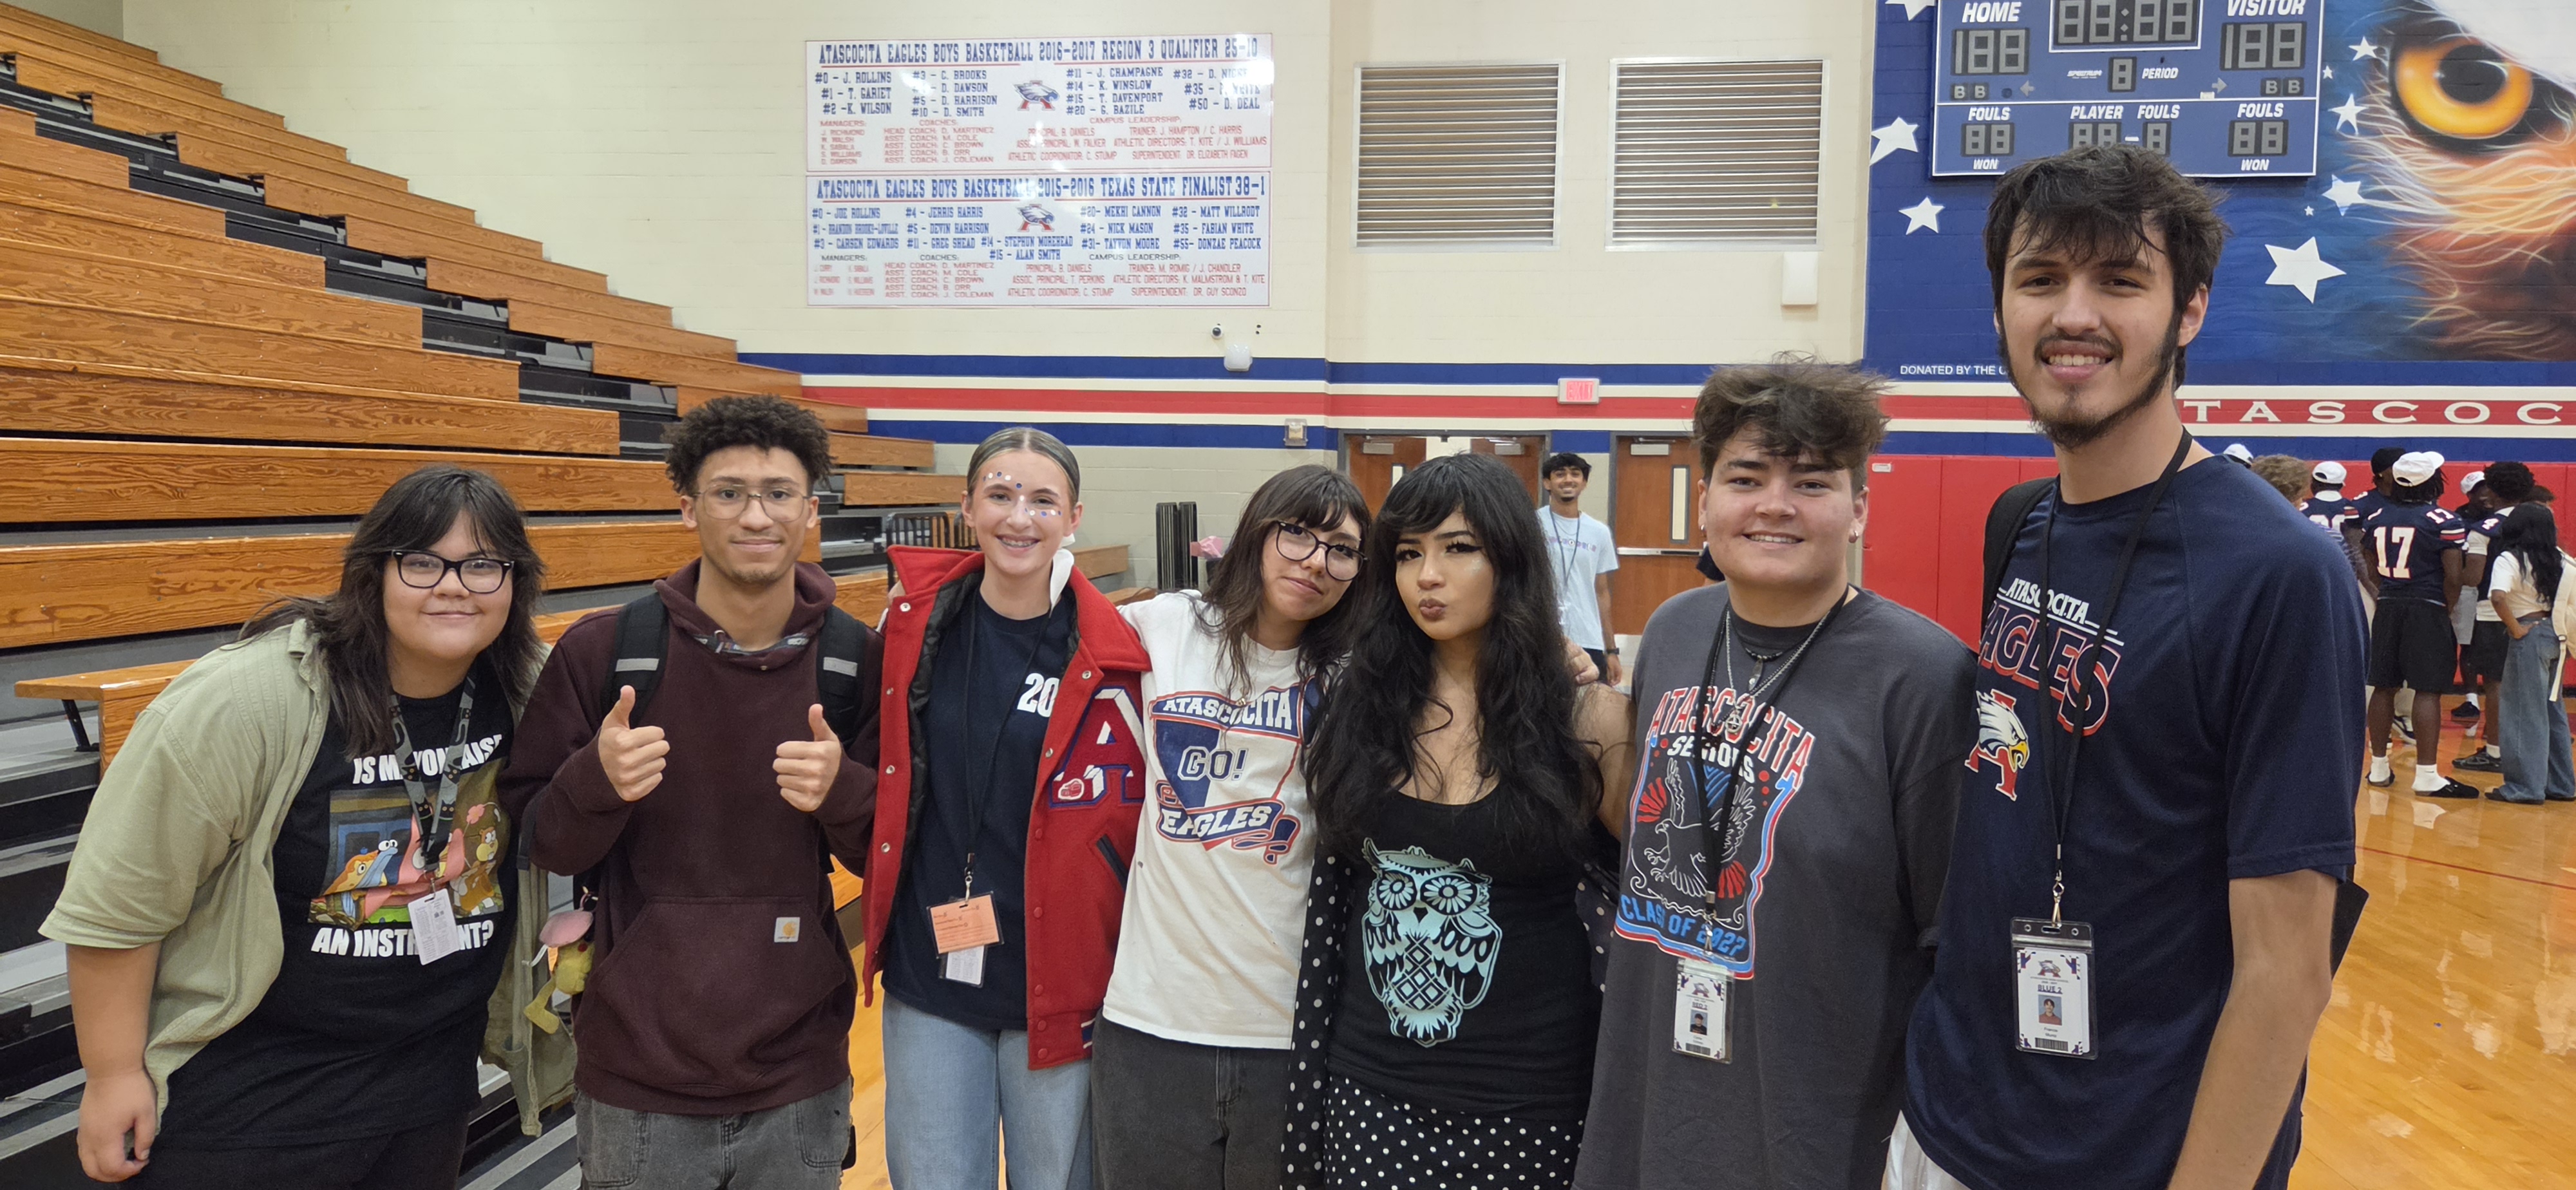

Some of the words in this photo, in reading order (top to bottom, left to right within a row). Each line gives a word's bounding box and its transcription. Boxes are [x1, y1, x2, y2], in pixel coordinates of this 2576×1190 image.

[1962, 1, 2022, 23] HOME
[2227, 0, 2306, 16] VISITOR
[819, 44, 882, 64] ATASCOCITA
[888, 44, 927, 63] EAGLES
[934, 43, 959, 62] BOYS
[966, 42, 1033, 62] BASKETBALL
[1039, 41, 1095, 61] 2016-2017
[1103, 40, 1142, 60] REGION
[1149, 40, 1154, 59] 3
[1161, 39, 1218, 59] QUALIFIER
[1225, 38, 1258, 58] 25-10
[815, 72, 828, 84] #0
[843, 72, 851, 84] J.
[856, 71, 891, 84] ROLLINS
[912, 70, 925, 80] #3
[941, 70, 949, 80] C.
[954, 70, 987, 80] BROOKS
[1066, 68, 1081, 79] #11
[1097, 68, 1105, 78] J.
[1110, 67, 1163, 77] CHAMPAGNE
[1173, 69, 1192, 79] #32
[1209, 68, 1217, 79] D.
[2142, 68, 2179, 79] PERIOD
[942, 83, 949, 93] D.
[954, 82, 989, 93] DAWSON
[1066, 81, 1083, 91] #14
[1099, 80, 1108, 91] K.
[1112, 80, 1153, 91] WINSLOW
[1184, 83, 1204, 95] #35
[821, 88, 833, 99] #1
[848, 88, 857, 99] T.
[1066, 94, 1083, 104] #15
[1099, 93, 1107, 104] T.
[1112, 92, 1163, 104] DAVENPORT
[912, 96, 926, 106] #5
[942, 96, 949, 106] D.
[954, 95, 998, 106] HARRISON
[1189, 98, 1208, 109] #50
[1224, 97, 1232, 109] D.
[1237, 97, 1260, 109] DEAL
[823, 103, 836, 115] #2
[860, 102, 892, 115] WILSON
[911, 108, 928, 117] #10
[943, 108, 952, 117] D.
[956, 107, 985, 117] SMITH
[1066, 106, 1085, 115] #20
[1113, 104, 1144, 115] BAZILE
[1968, 107, 2011, 121] FOULS
[2070, 106, 2124, 119] PLAYER
[2137, 104, 2181, 118] FOULS
[2237, 103, 2284, 118] FOULS
[1973, 159, 1999, 169] WON
[2241, 159, 2269, 171] WON
[817, 180, 880, 199] ATASCOCITA
[886, 179, 925, 198] EAGLES
[932, 179, 958, 198] BOYS
[964, 178, 1032, 198] BASKETBA
[1038, 178, 1094, 197] 2015-2016
[1101, 177, 1135, 197] TEXAS
[1142, 176, 1175, 196] STATE
[1182, 176, 1232, 196] FINALIST
[1236, 176, 1265, 195] 38-1
[812, 208, 823, 219] #0
[834, 208, 848, 219] JOE
[851, 207, 880, 219] ROLLINS
[905, 207, 916, 218] #4
[928, 207, 954, 218] JERRIS
[958, 207, 983, 218] HARRIS
[1104, 205, 1128, 218] MEKHI
[1132, 205, 1161, 217] CANNON
[1172, 206, 1188, 218] #32
[1200, 206, 1220, 218] MATT
[907, 223, 918, 234] #5
[929, 223, 951, 234] DEVIN
[954, 223, 989, 234] HARRISON
[1081, 223, 1095, 234] #24
[1108, 223, 1125, 234] NICK
[1129, 222, 1153, 234] MASON
[1173, 223, 1189, 234] #35
[1202, 223, 1227, 234] FABIAN
[1231, 222, 1254, 234] WHITE
[837, 238, 864, 249] CARSEN
[867, 238, 899, 249] EDWARDS
[907, 238, 919, 249] #11
[931, 238, 949, 249] GREG
[953, 237, 975, 249] SHEAD
[981, 236, 994, 247] #14
[1037, 236, 1074, 247] MOREHEAD
[1104, 238, 1132, 249] TAYVON
[1135, 238, 1160, 249] MOORE
[1198, 238, 1226, 249] DONZAE
[1229, 238, 1262, 249] PEACOCK
[990, 249, 1003, 260] #15
[1016, 249, 1035, 260] ALAN
[1038, 249, 1061, 260] SMITH
[1208, 263, 1241, 272] CHANDLER
[1251, 274, 1265, 283] KITE
[1092, 288, 1114, 296] STUMP
[1206, 287, 1219, 296] GUY
[1900, 365, 1954, 375] DONATED
[1956, 365, 1971, 375] BY
[1974, 365, 1996, 375] THE
[1567, 381, 1594, 401] EXIT
[2482, 518, 2500, 531] 4
[2374, 526, 2416, 579] 17
[1978, 600, 2122, 737] AGLES
[1163, 689, 1293, 730] ATASCOCITA
[352, 757, 376, 784] IS
[379, 734, 502, 782] MYONAIS
[1177, 746, 1249, 781] GO!
[1667, 736, 1755, 784] SEIOS
[1160, 806, 1273, 838] EAGLES
[310, 927, 350, 956] AN
[353, 920, 495, 957] INSTRNT?
[1668, 914, 1696, 937] OF
[1696, 924, 1747, 957] 2027
